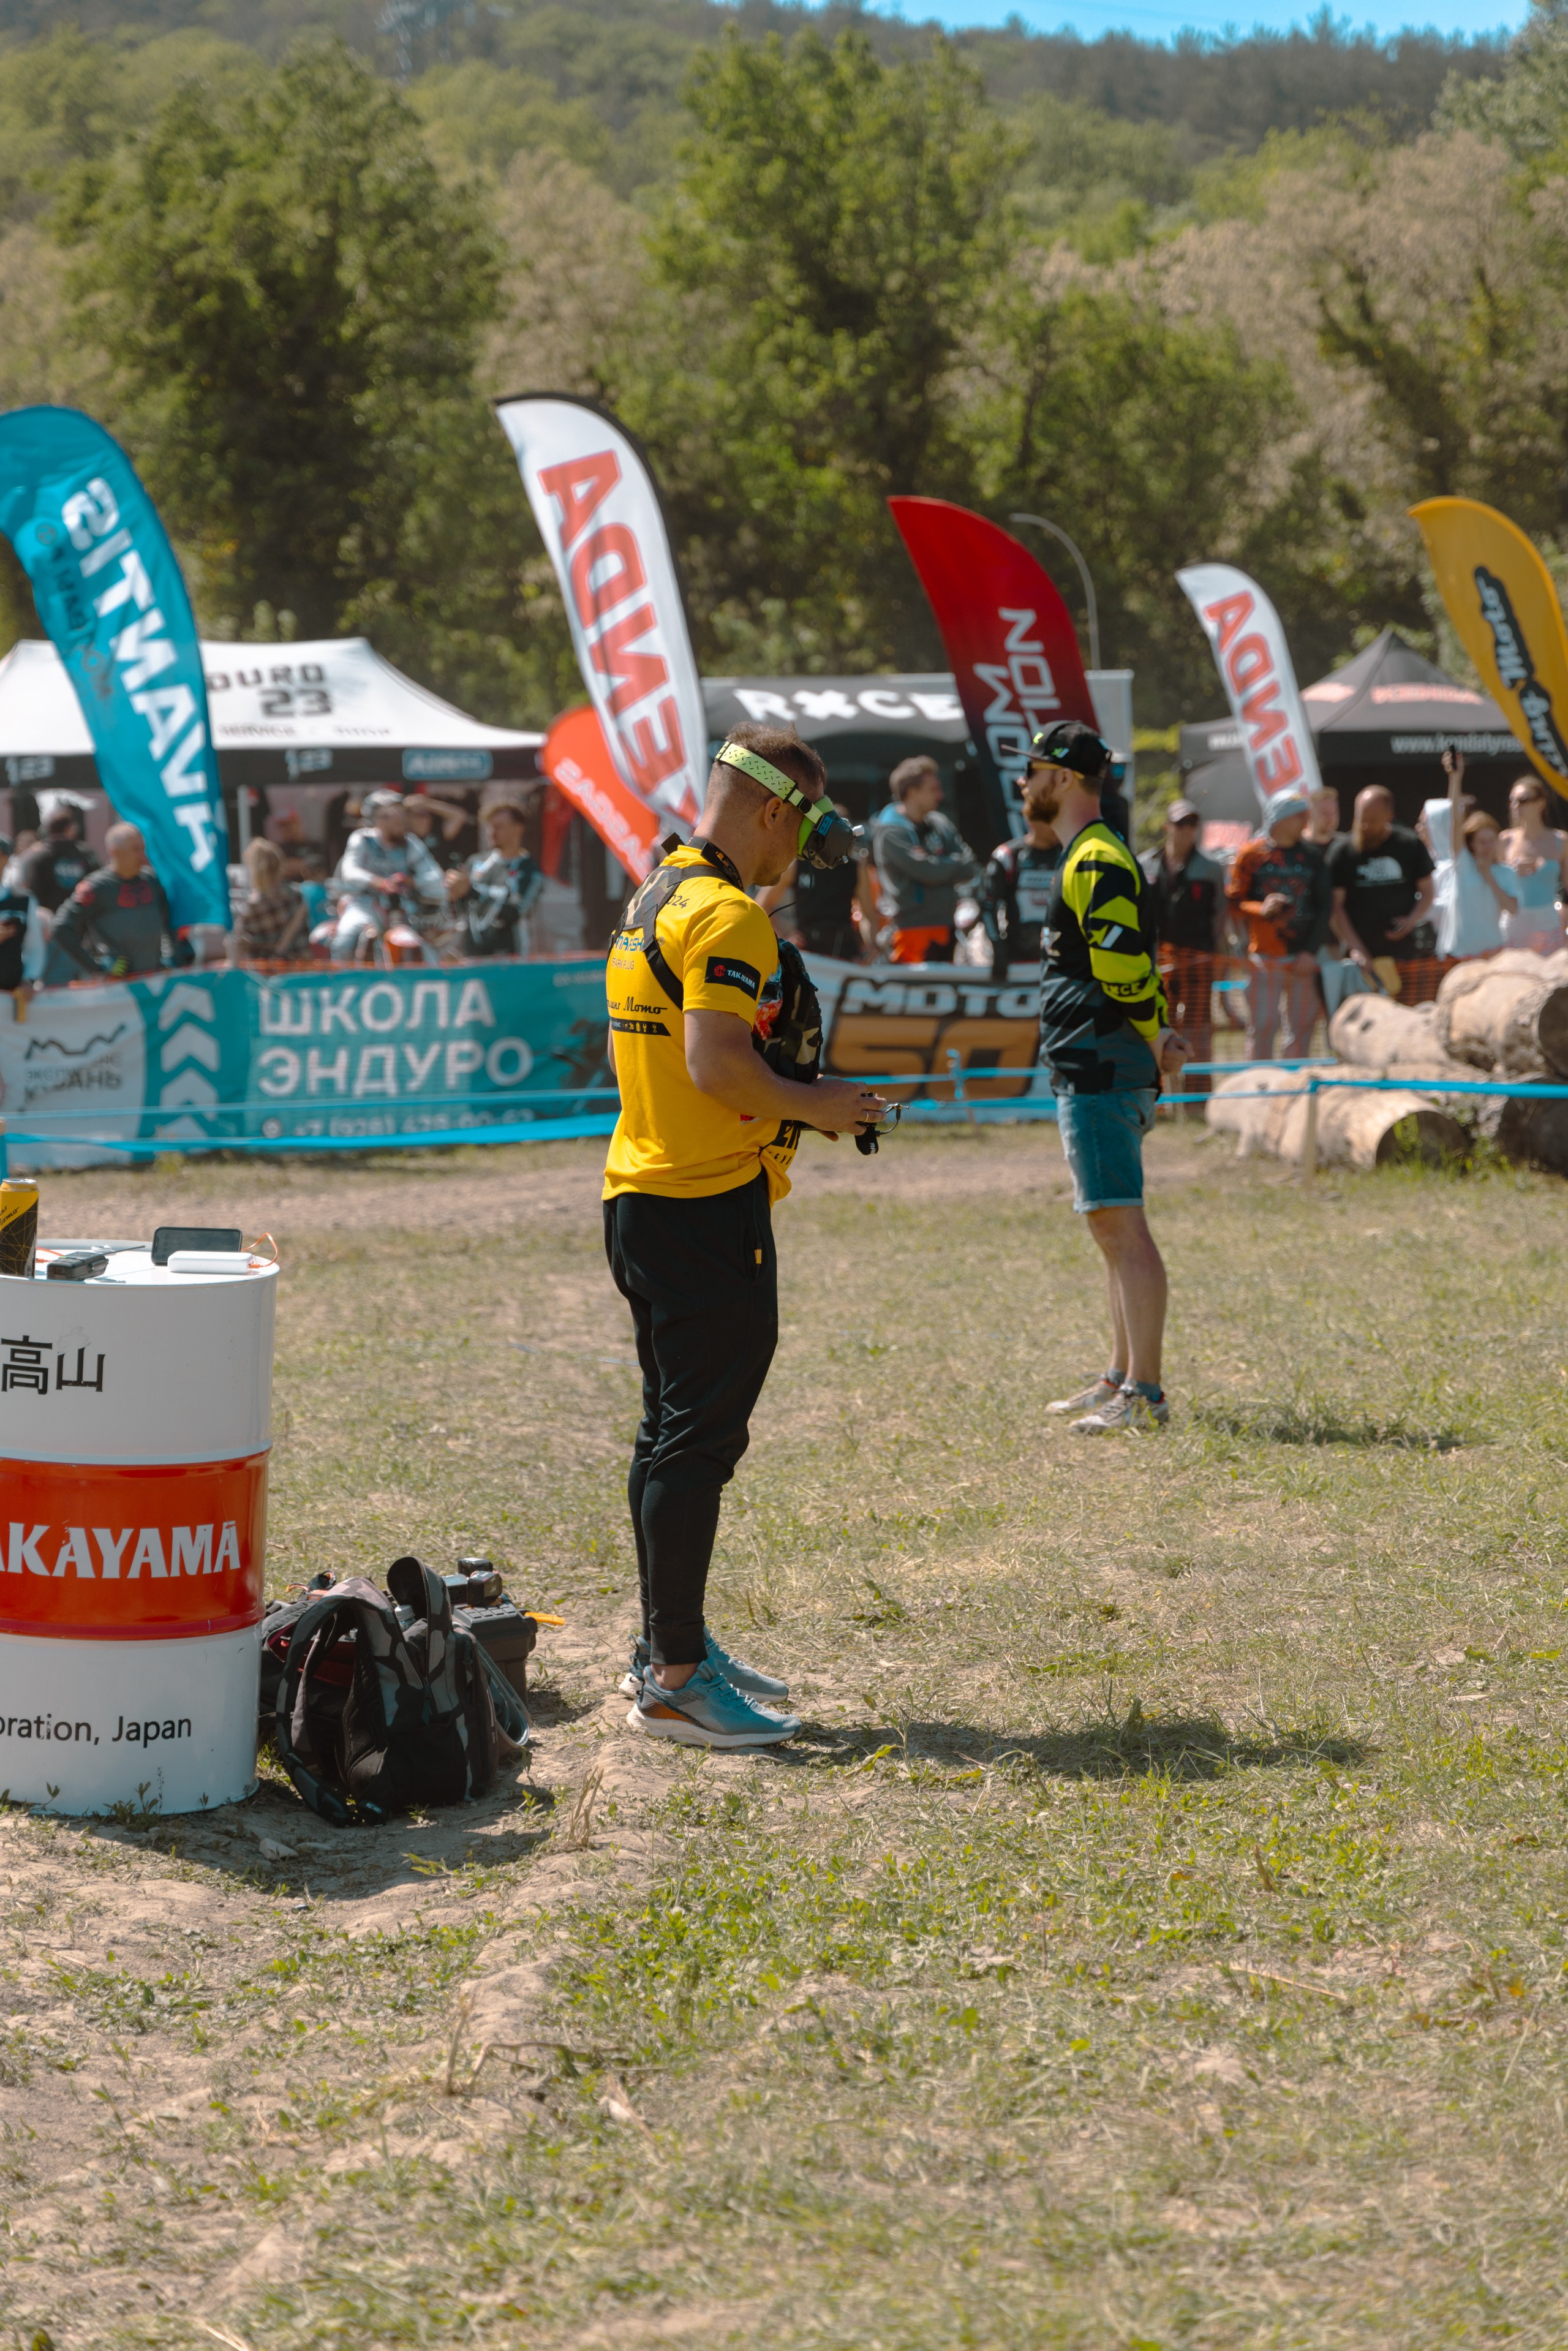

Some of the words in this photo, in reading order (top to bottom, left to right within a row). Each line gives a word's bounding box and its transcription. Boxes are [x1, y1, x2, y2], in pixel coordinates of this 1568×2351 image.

[258, 688, 331, 715] 23
[666, 894, 690, 908] 024
[259, 978, 496, 1035] ШКОЛА
[257, 1037, 533, 1097] ЭНДУРО
[1, 1335, 106, 1395] 高山
[0, 1520, 241, 1579] KAYAMA
[111, 1716, 192, 1748] Japan
